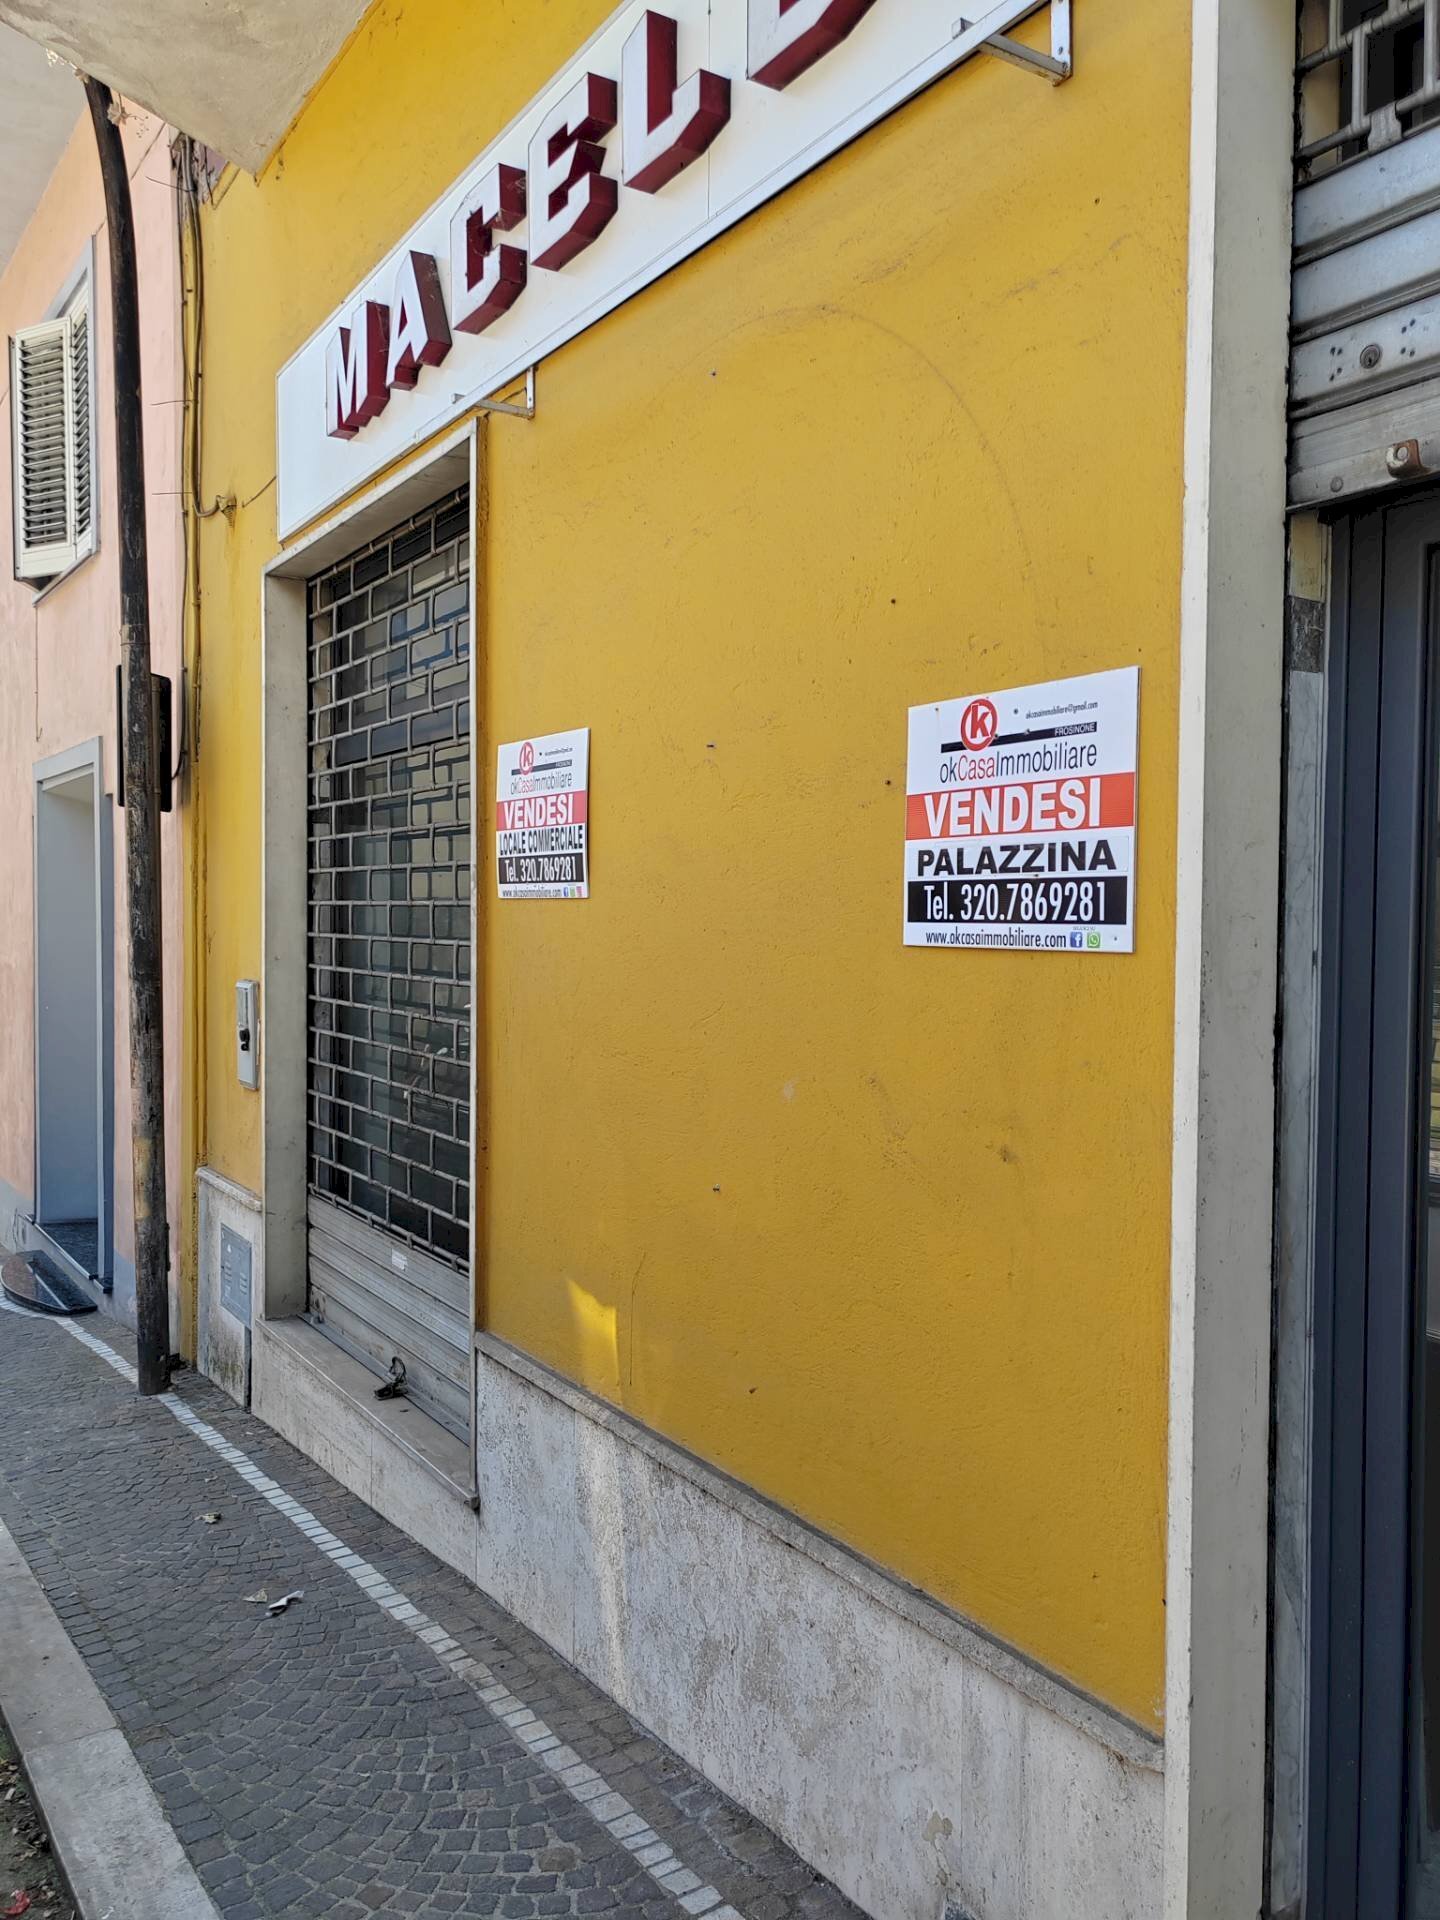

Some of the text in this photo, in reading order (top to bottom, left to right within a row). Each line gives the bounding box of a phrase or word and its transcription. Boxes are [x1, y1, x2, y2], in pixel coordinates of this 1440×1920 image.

[1054, 722, 1096, 736] FROSINONE
[940, 743, 1097, 784] okCasaImmobiliare
[504, 794, 573, 829] VENDESI
[924, 777, 1101, 837] VENDESI
[500, 825, 583, 856] LOCALE COMMERCIALE
[917, 839, 1117, 877] PALAZZINA
[505, 855, 577, 883] Tel. 320.7869281
[924, 881, 1105, 922] Tel. 320.7869281
[926, 926, 1067, 948] www.okcasaimmobiliare.com
